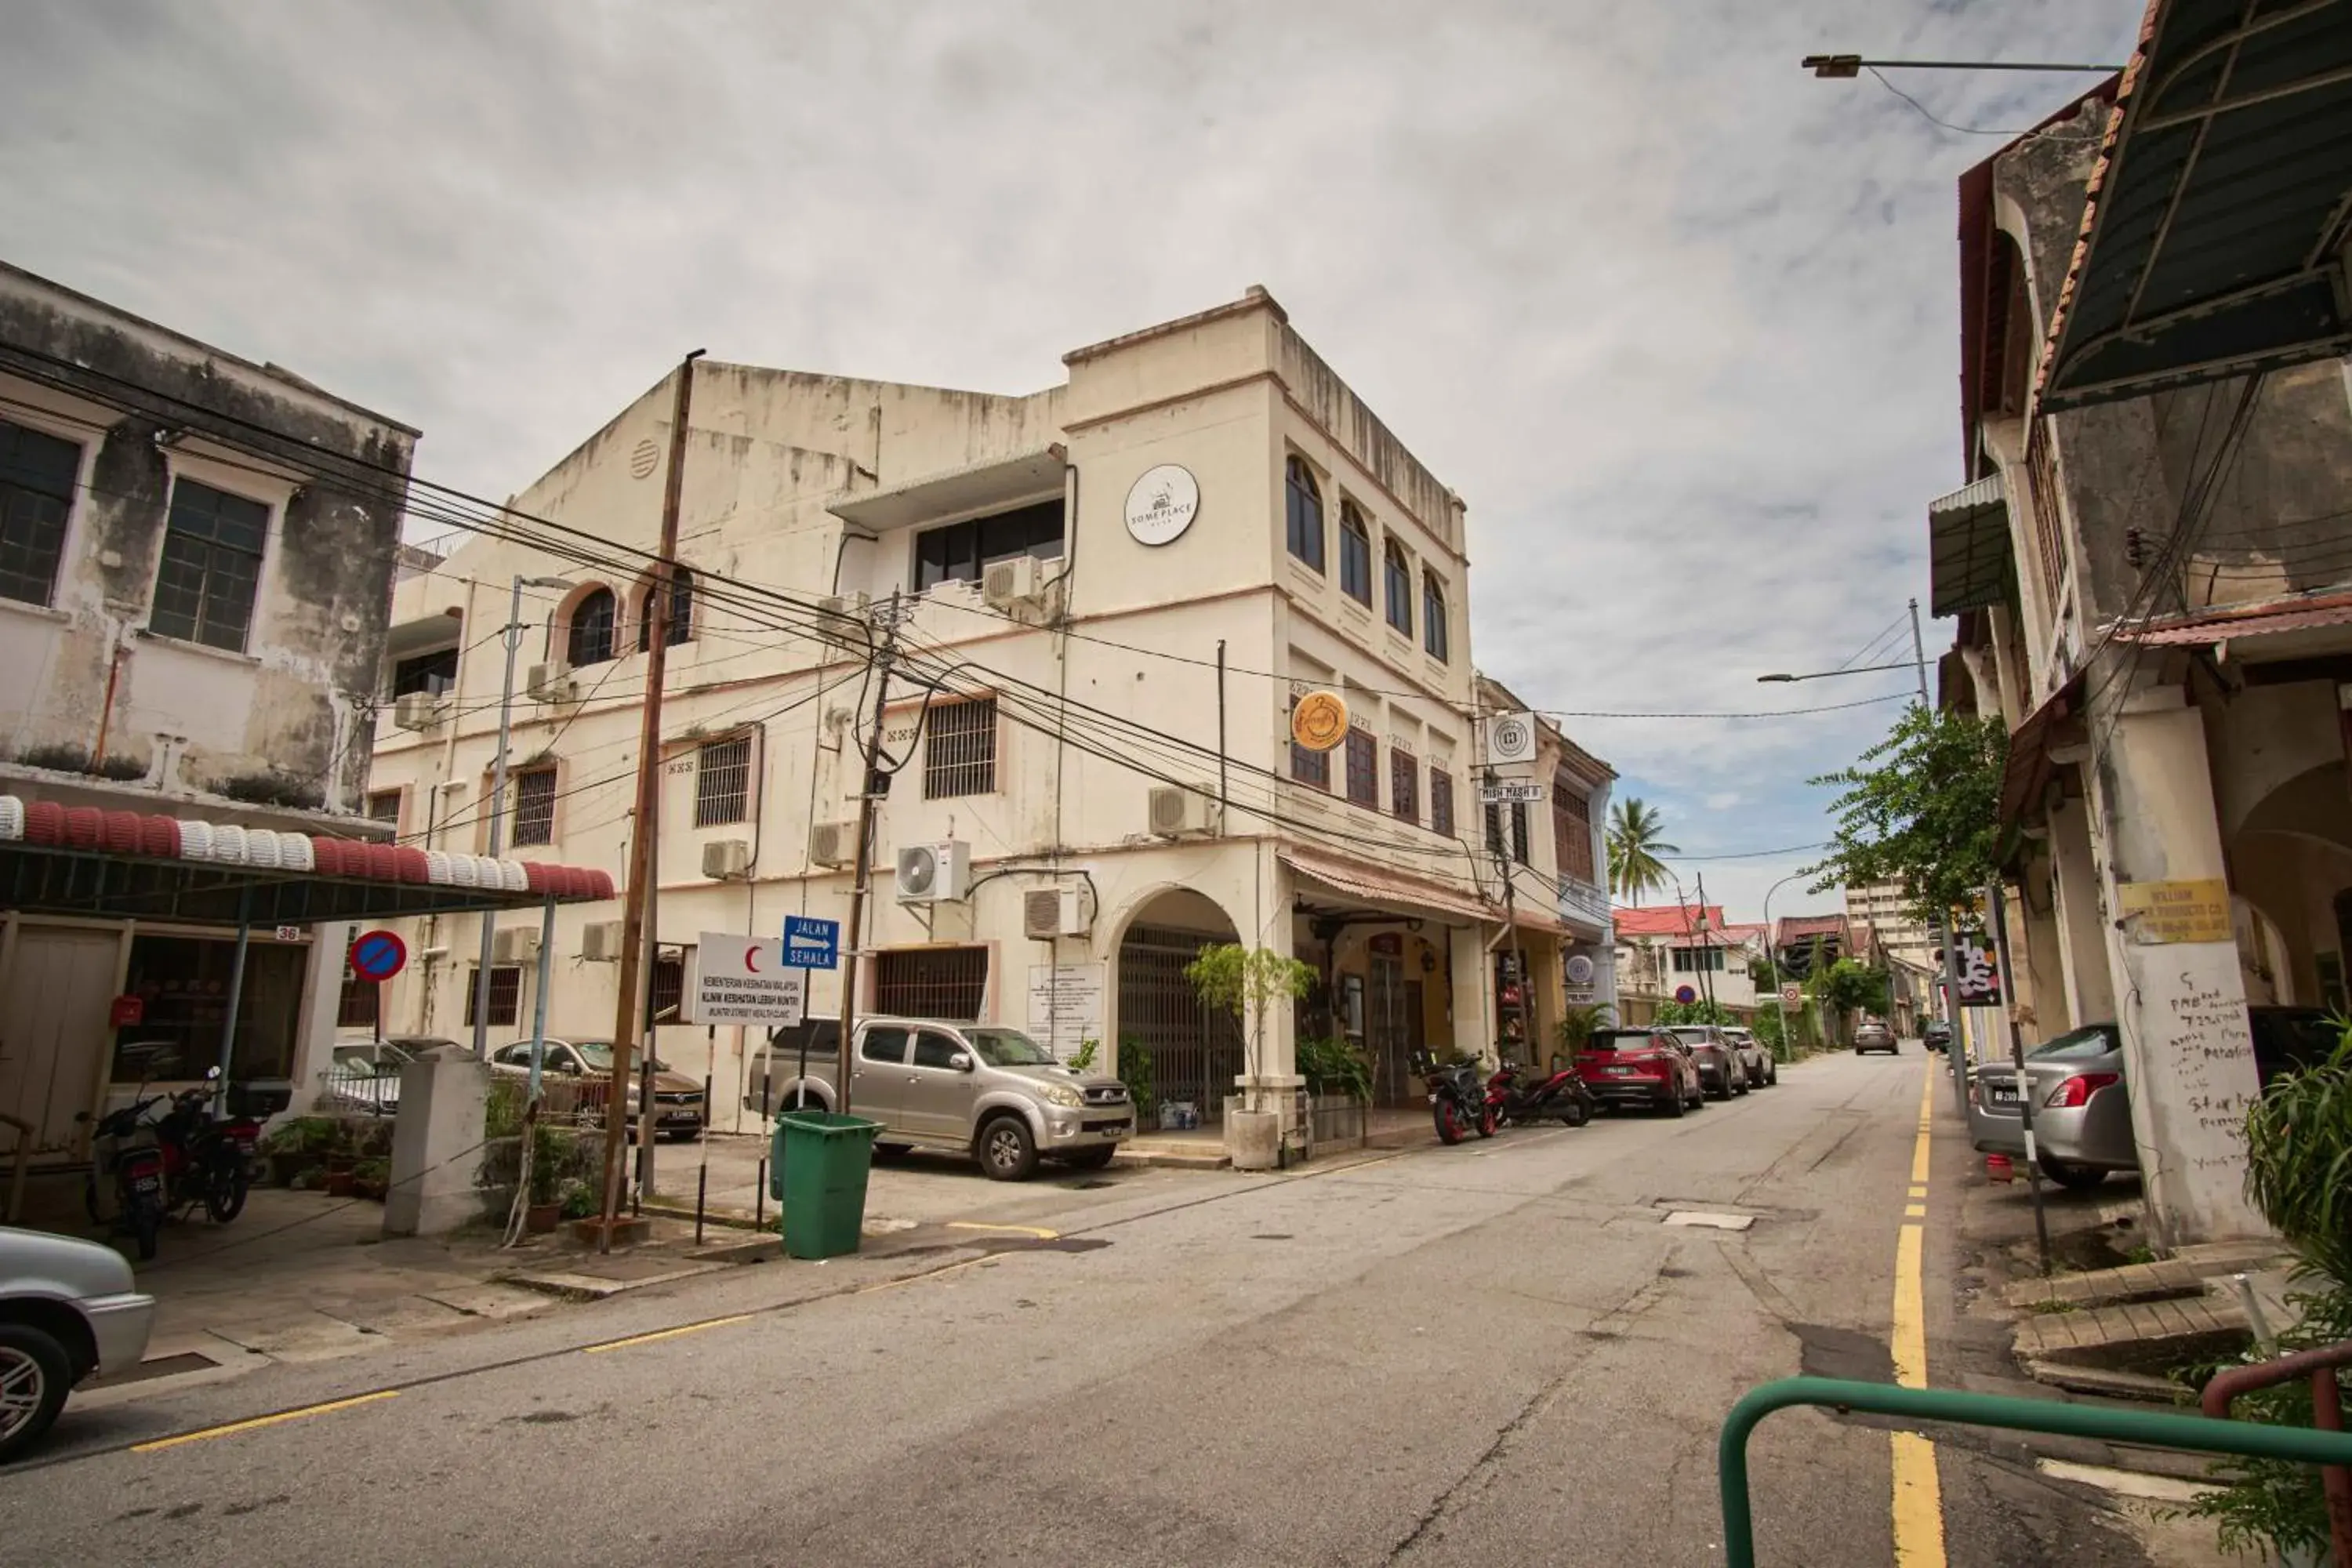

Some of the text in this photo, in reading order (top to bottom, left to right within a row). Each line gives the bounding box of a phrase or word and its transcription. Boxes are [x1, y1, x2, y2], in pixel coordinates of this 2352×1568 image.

[1483, 786, 1529, 799] MISH MASH
[278, 927, 296, 940] 36
[796, 920, 829, 936] JALAN
[789, 949, 830, 964] SEHALA
[702, 992, 722, 1003] KLINIK
